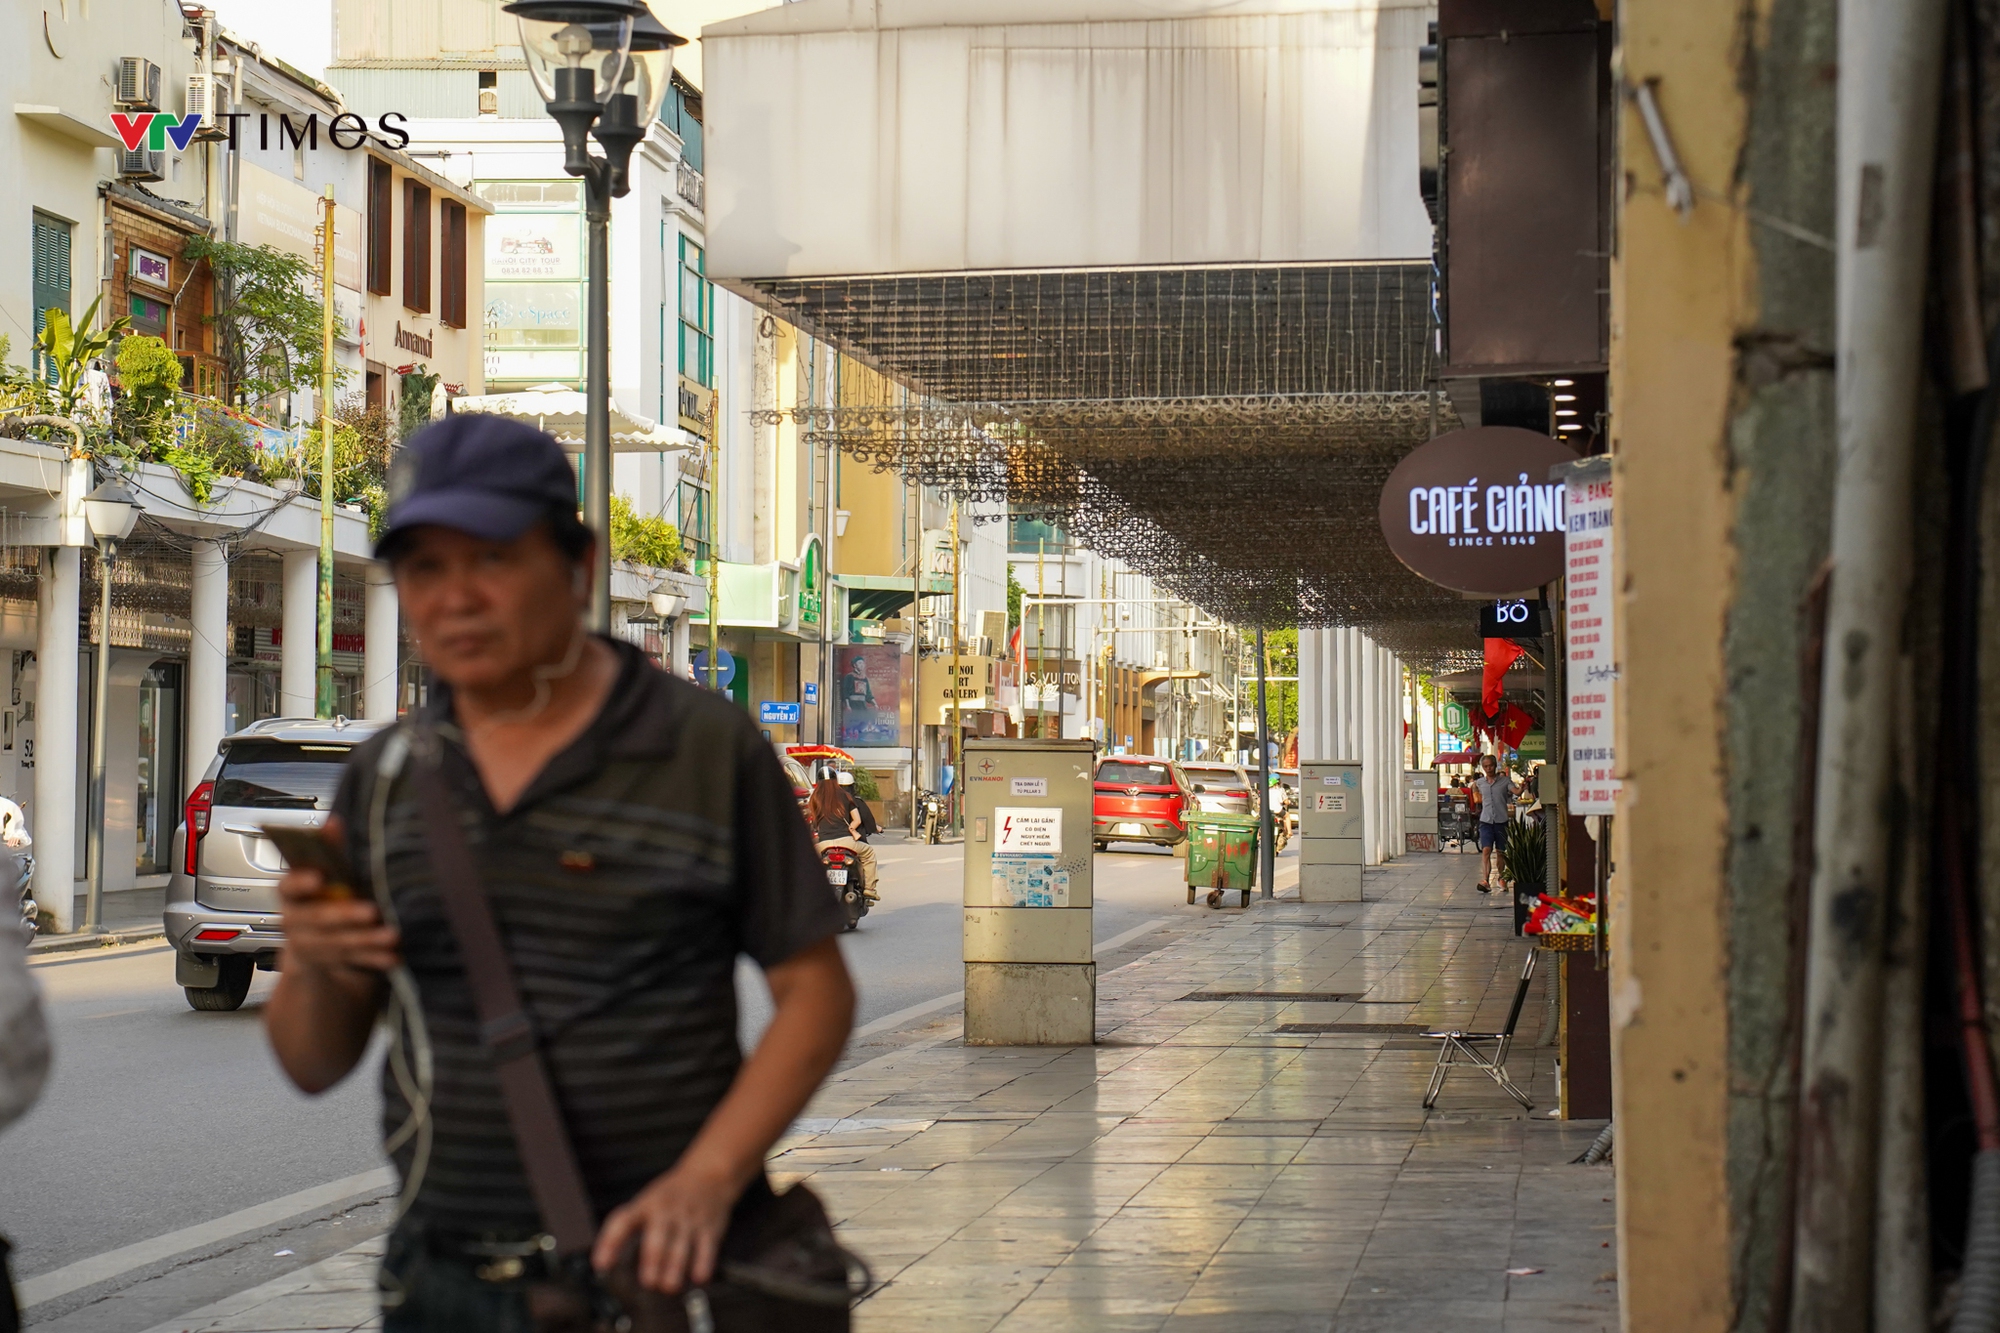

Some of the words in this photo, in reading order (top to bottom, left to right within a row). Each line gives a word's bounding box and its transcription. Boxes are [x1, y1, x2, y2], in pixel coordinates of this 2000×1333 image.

[1410, 478, 1478, 534] CAFÉ
[1569, 513, 1586, 534] KEM
[1449, 536, 1493, 546] SINCE
[1502, 536, 1536, 545] 1946
[948, 666, 974, 675] HNOI
[944, 688, 978, 698] GALERY
[25, 739, 33, 757] 52
